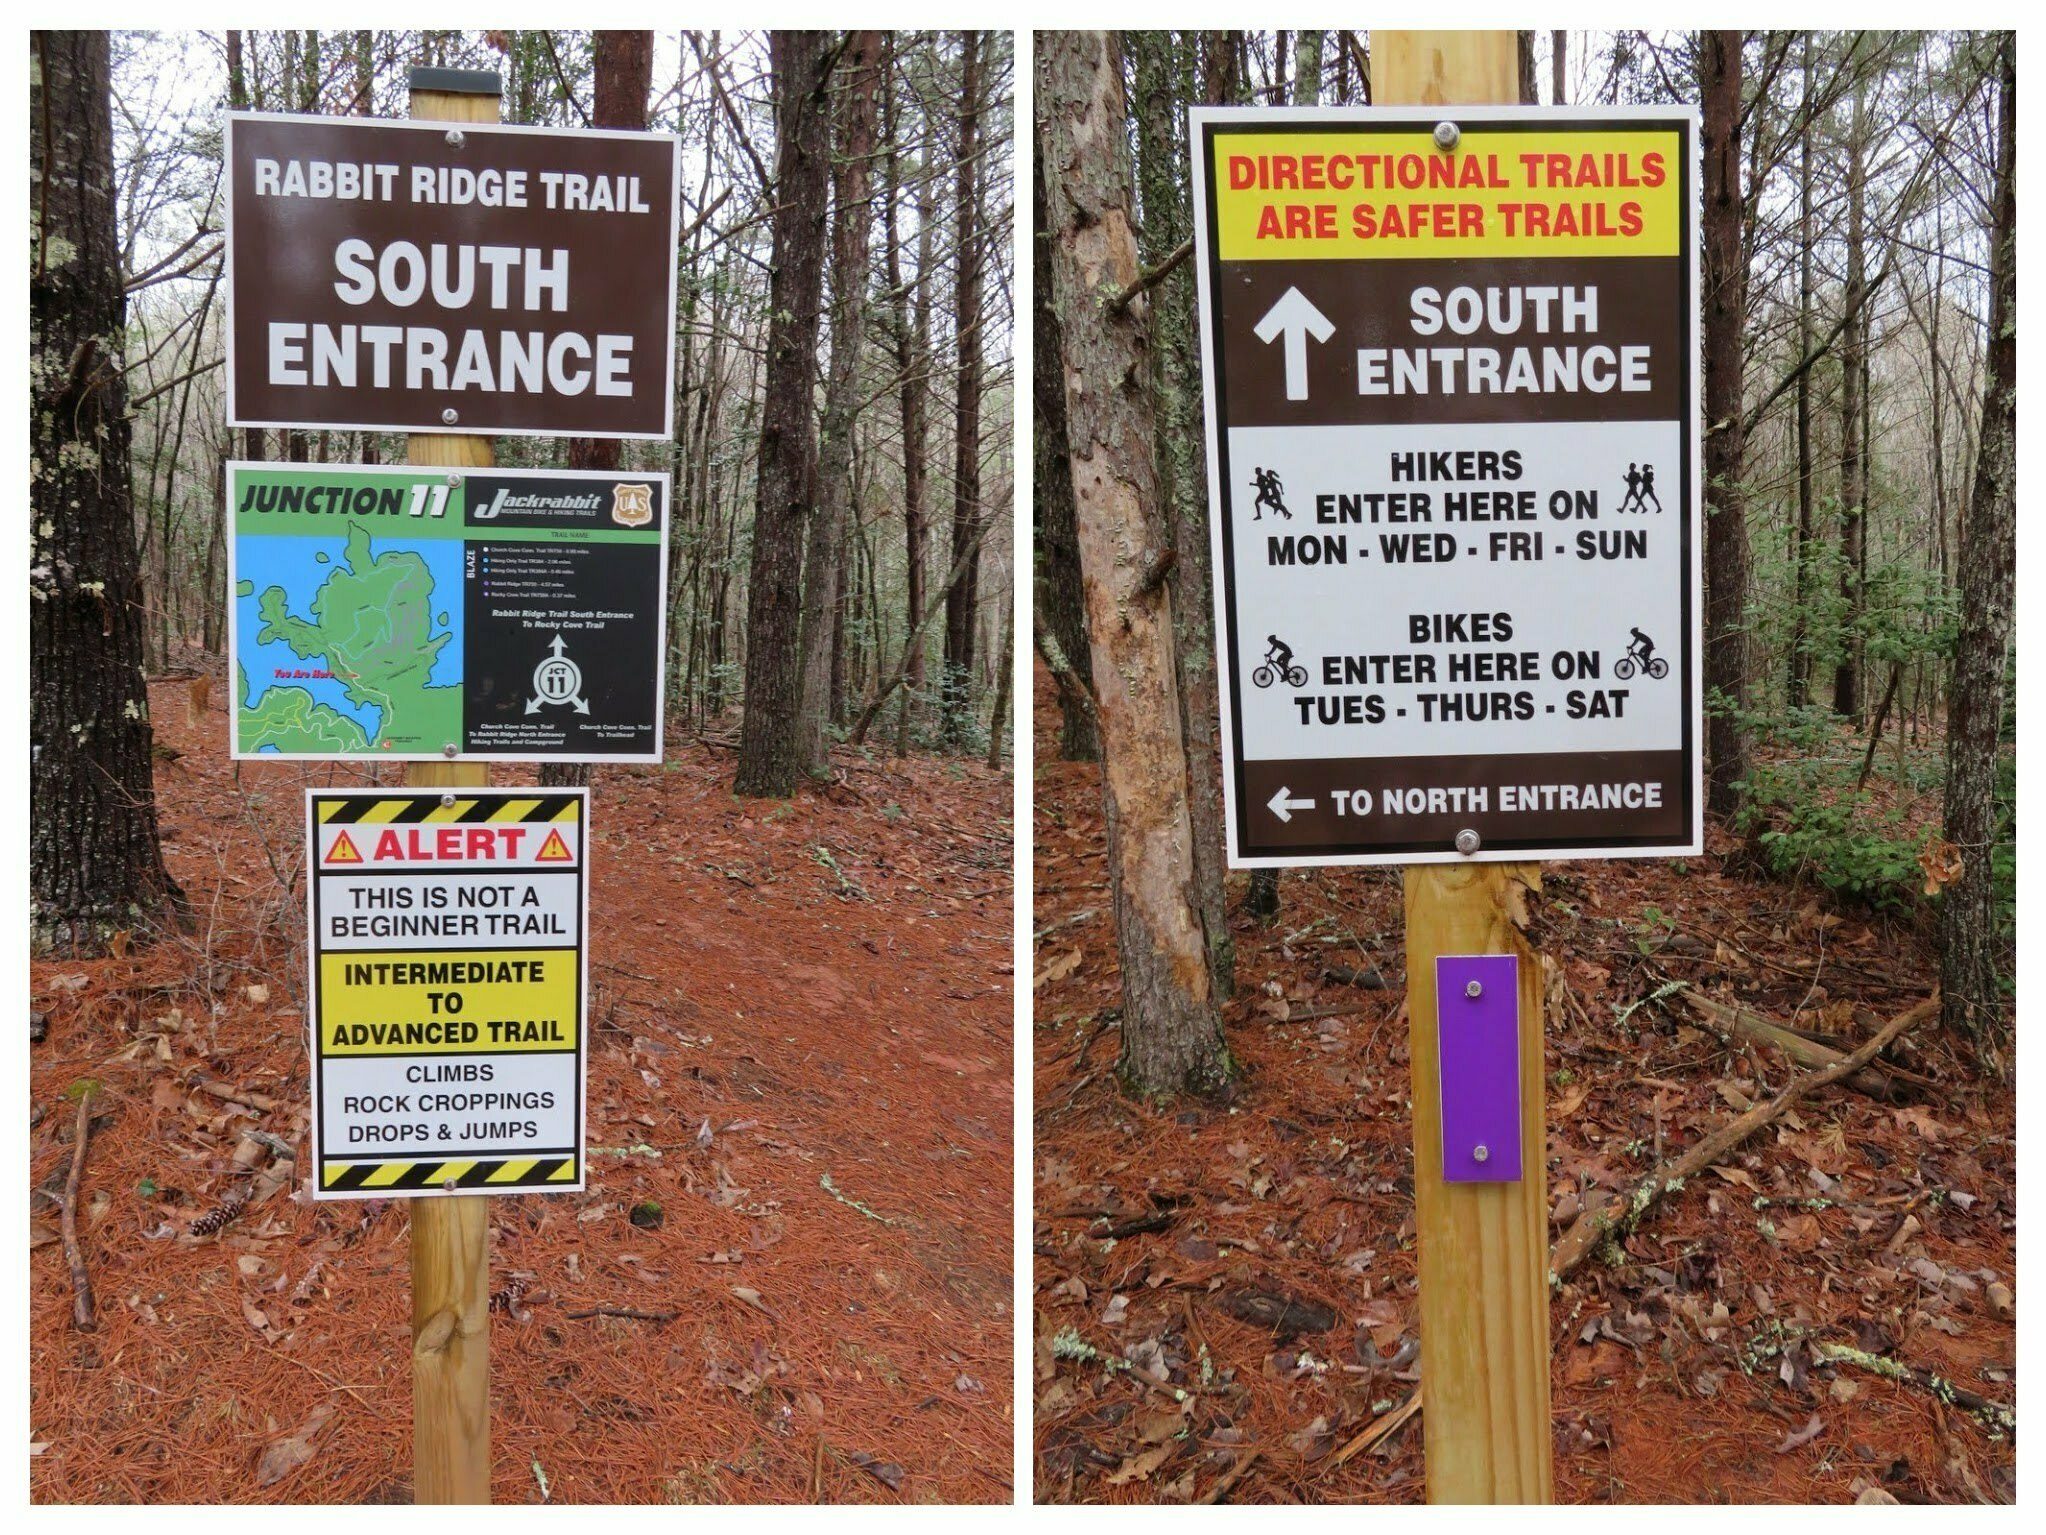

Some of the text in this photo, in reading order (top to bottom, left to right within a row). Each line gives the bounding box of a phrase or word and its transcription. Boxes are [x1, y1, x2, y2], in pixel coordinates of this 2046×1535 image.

[256, 159, 649, 213] RABBIT RIDGE TRAIL
[1229, 152, 1665, 190] DIRECTIONAL TRAILS
[1256, 202, 1644, 239] ARE SAFER TRAILS
[334, 239, 569, 312] SOUTH
[1410, 286, 1598, 336] SOUTH
[268, 322, 634, 397] ENTRANCE
[1357, 345, 1651, 395] ENTRANCE
[1391, 450, 1523, 482] HIKERS
[239, 484, 450, 518] JUNCTION 11
[474, 489, 601, 518] Jackrabbit
[1316, 490, 1599, 524] ENTER HERE ON
[1267, 535, 1348, 566] MON
[1380, 533, 1457, 564] WED
[1489, 532, 1543, 562] FRI
[1576, 530, 1648, 560] SUN
[466, 550, 475, 578] BLAZE
[492, 609, 520, 617] Rabbit
[522, 610, 546, 619] Ridge
[570, 610, 594, 618] South
[535, 621, 560, 630] Rocky
[1408, 613, 1513, 644] BIKES
[274, 669, 335, 678] You Are Here
[1323, 651, 1600, 686] ENTER HERE ON
[548, 676, 565, 693] 11
[1294, 695, 1386, 725] TUES
[1417, 692, 1534, 722] THURS
[1566, 689, 1629, 719] SAT
[1331, 782, 1662, 816] TO NORTH ENTRANCE
[373, 828, 526, 860] ALERT
[349, 886, 540, 909] THIS IS NOT A
[331, 914, 566, 938] BEGINNER TRAIL
[345, 961, 544, 986] INTERMEDIATE
[427, 992, 463, 1014] TO
[332, 1020, 565, 1046] ADVANCED TRAIL
[406, 1064, 494, 1083] CLIMBS
[344, 1092, 554, 1113] ROCK CROPPINGS
[348, 1120, 537, 1143] DROPS & JUMPS
